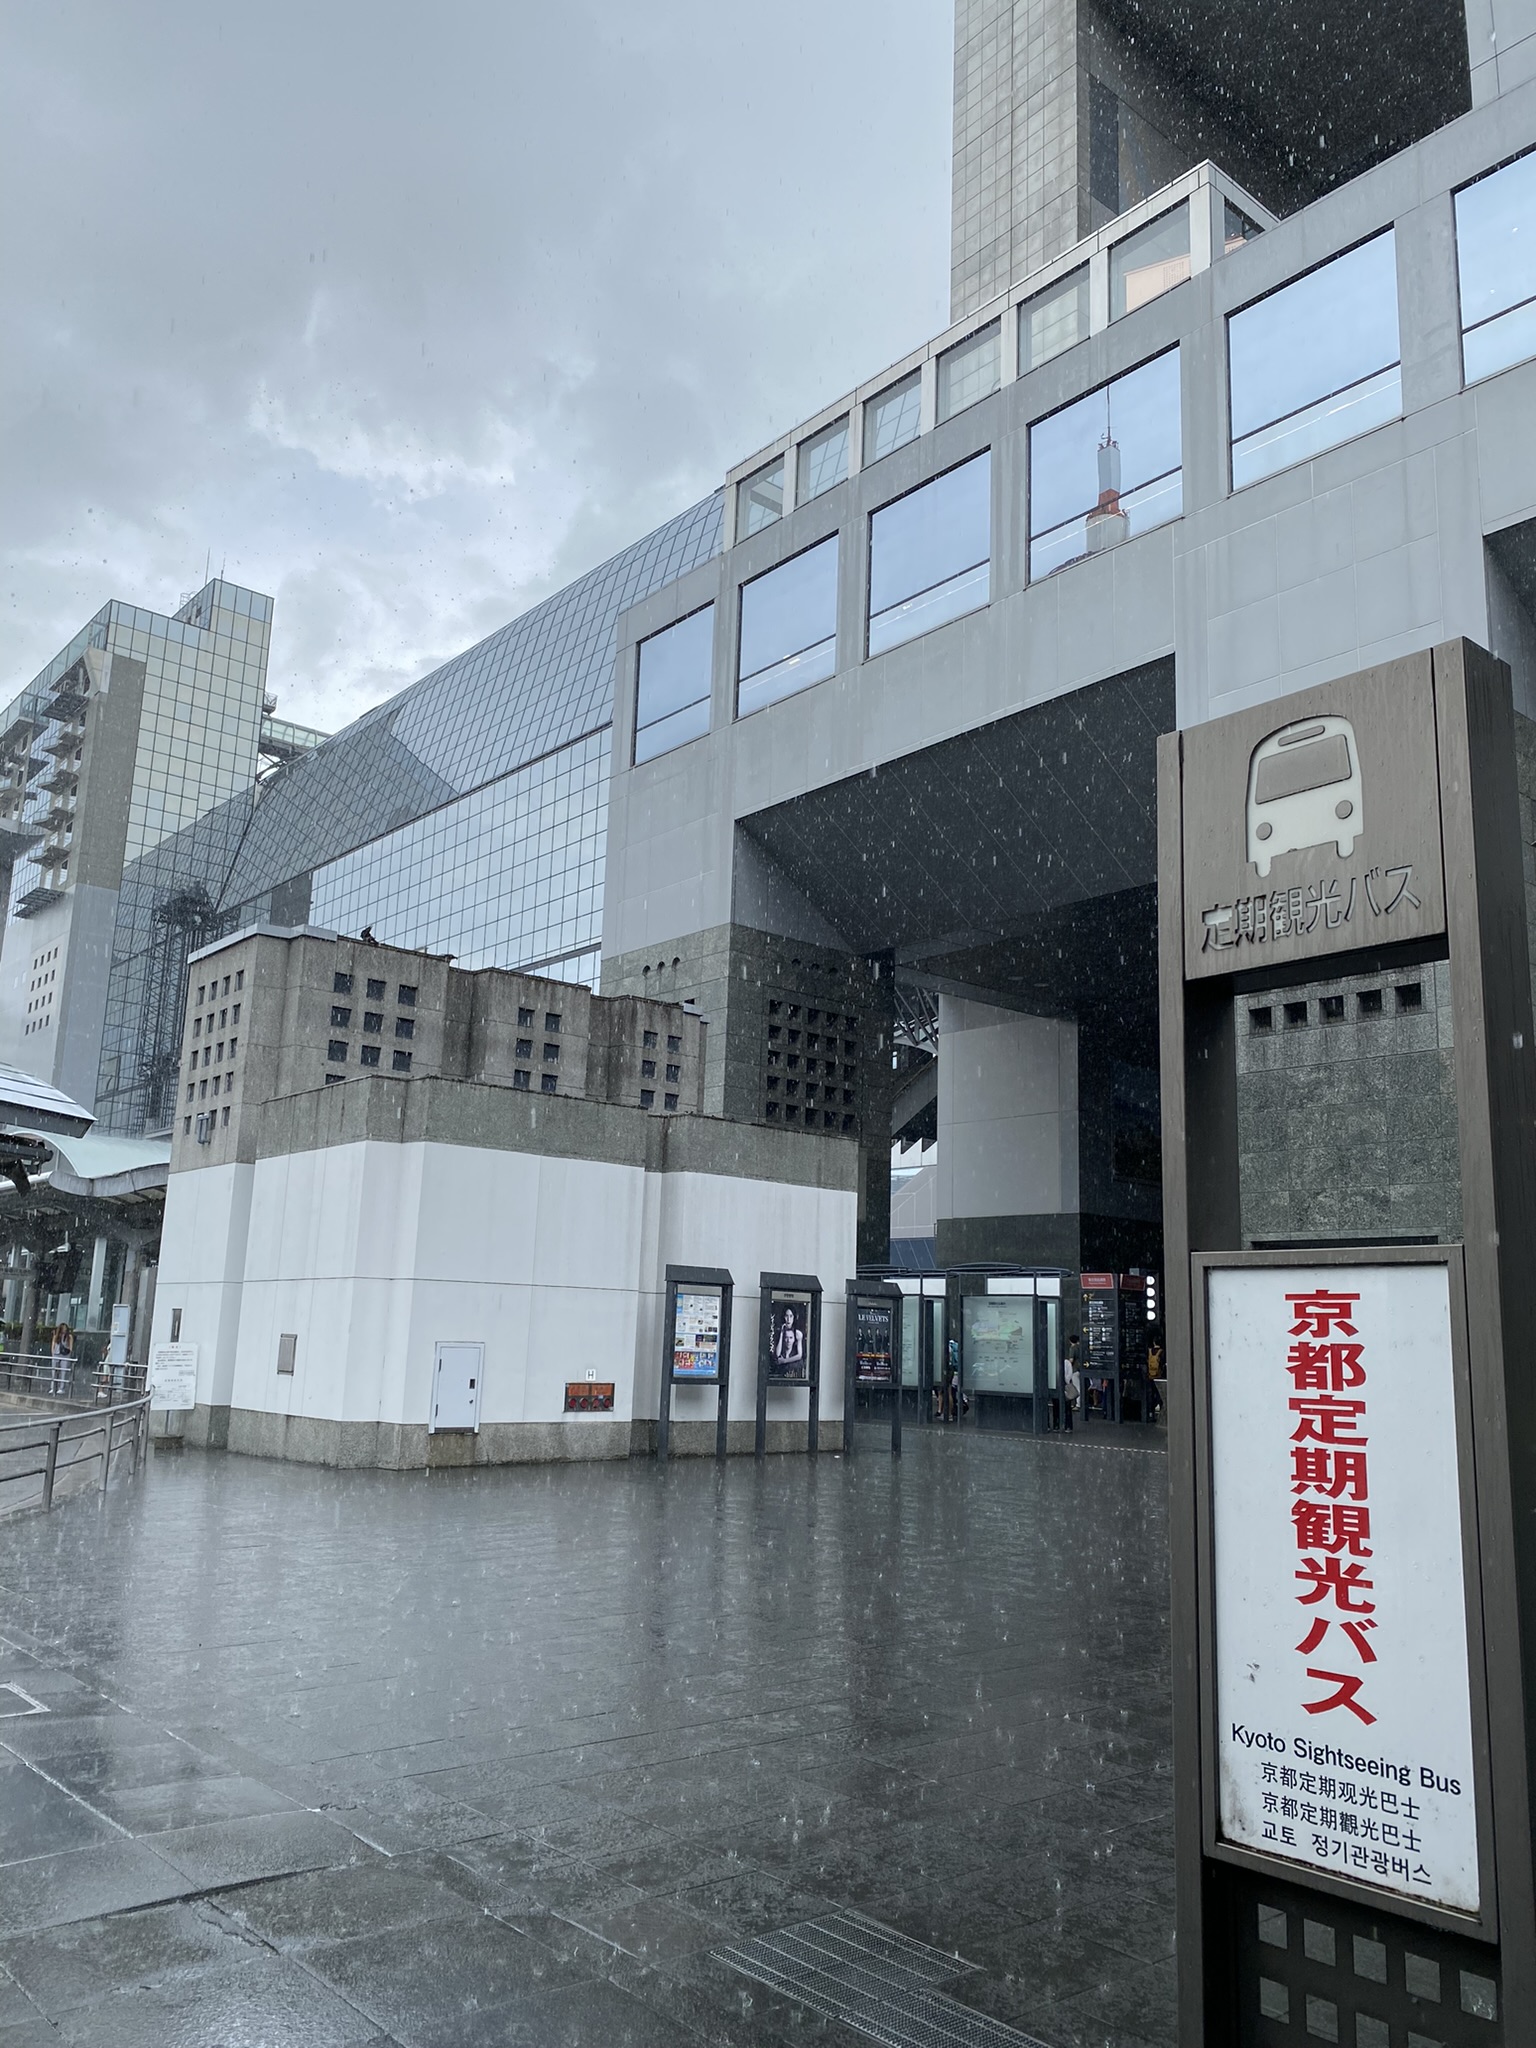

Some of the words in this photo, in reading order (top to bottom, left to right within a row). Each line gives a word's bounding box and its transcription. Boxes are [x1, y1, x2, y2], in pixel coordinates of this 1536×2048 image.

[1201, 864, 1422, 953] 定期観光バス
[587, 1370, 595, 1380] H
[1284, 1289, 1379, 1726] 京都定期観光バス
[1231, 1723, 1286, 1753] Kyoto
[1293, 1737, 1411, 1787] Sightseeing
[1419, 1766, 1462, 1796] Bus
[1260, 1761, 1421, 1821] 京都定期观光巴士
[1261, 1791, 1423, 1853] 京都定期觀光巴士
[1261, 1820, 1298, 1847] 교토
[1311, 1832, 1433, 1886] 정기관광버스
